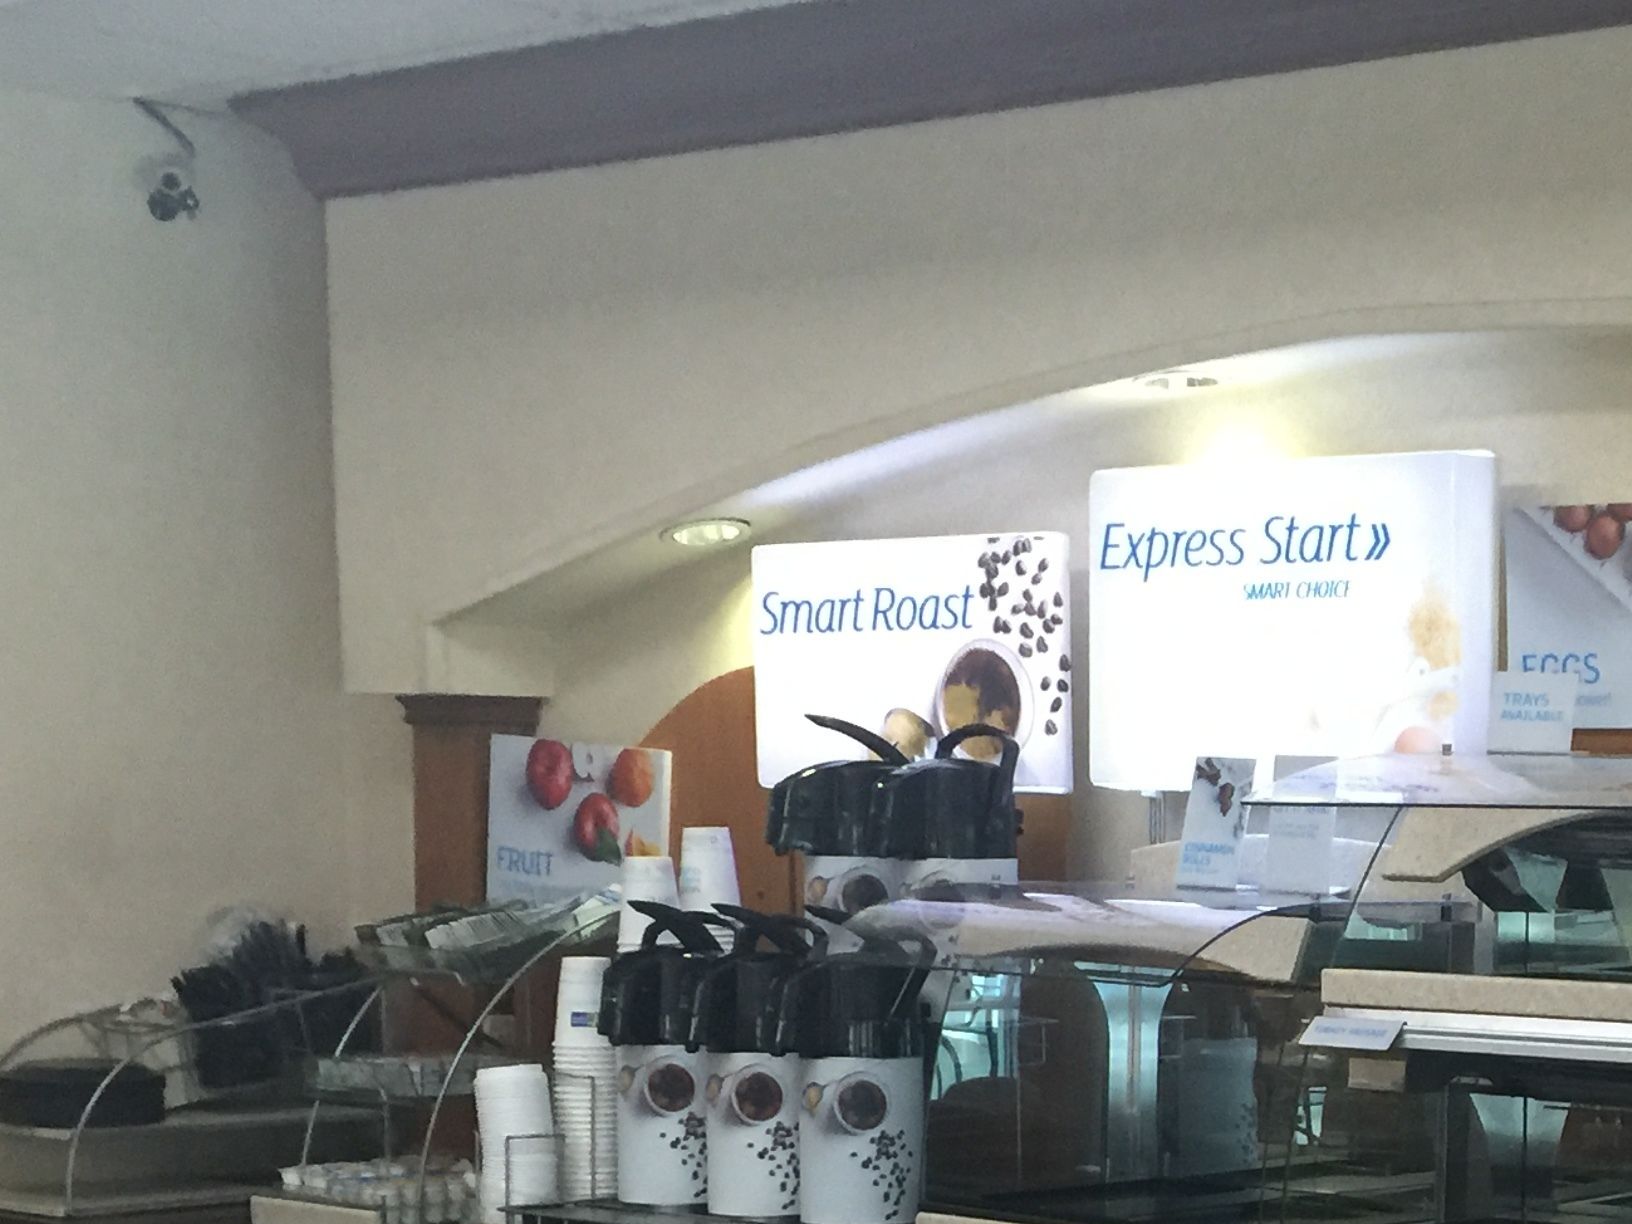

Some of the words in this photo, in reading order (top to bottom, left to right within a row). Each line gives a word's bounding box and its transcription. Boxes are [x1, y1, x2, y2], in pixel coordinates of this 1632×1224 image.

[1100, 523, 1247, 582] Express
[1259, 512, 1361, 565] Start
[1243, 581, 1291, 600] SMART
[759, 591, 865, 635] Smart
[871, 584, 976, 632] Roast
[1503, 692, 1550, 707] TRAYS
[1501, 710, 1564, 722] AVAILABLE
[497, 846, 553, 876] FRUIT
